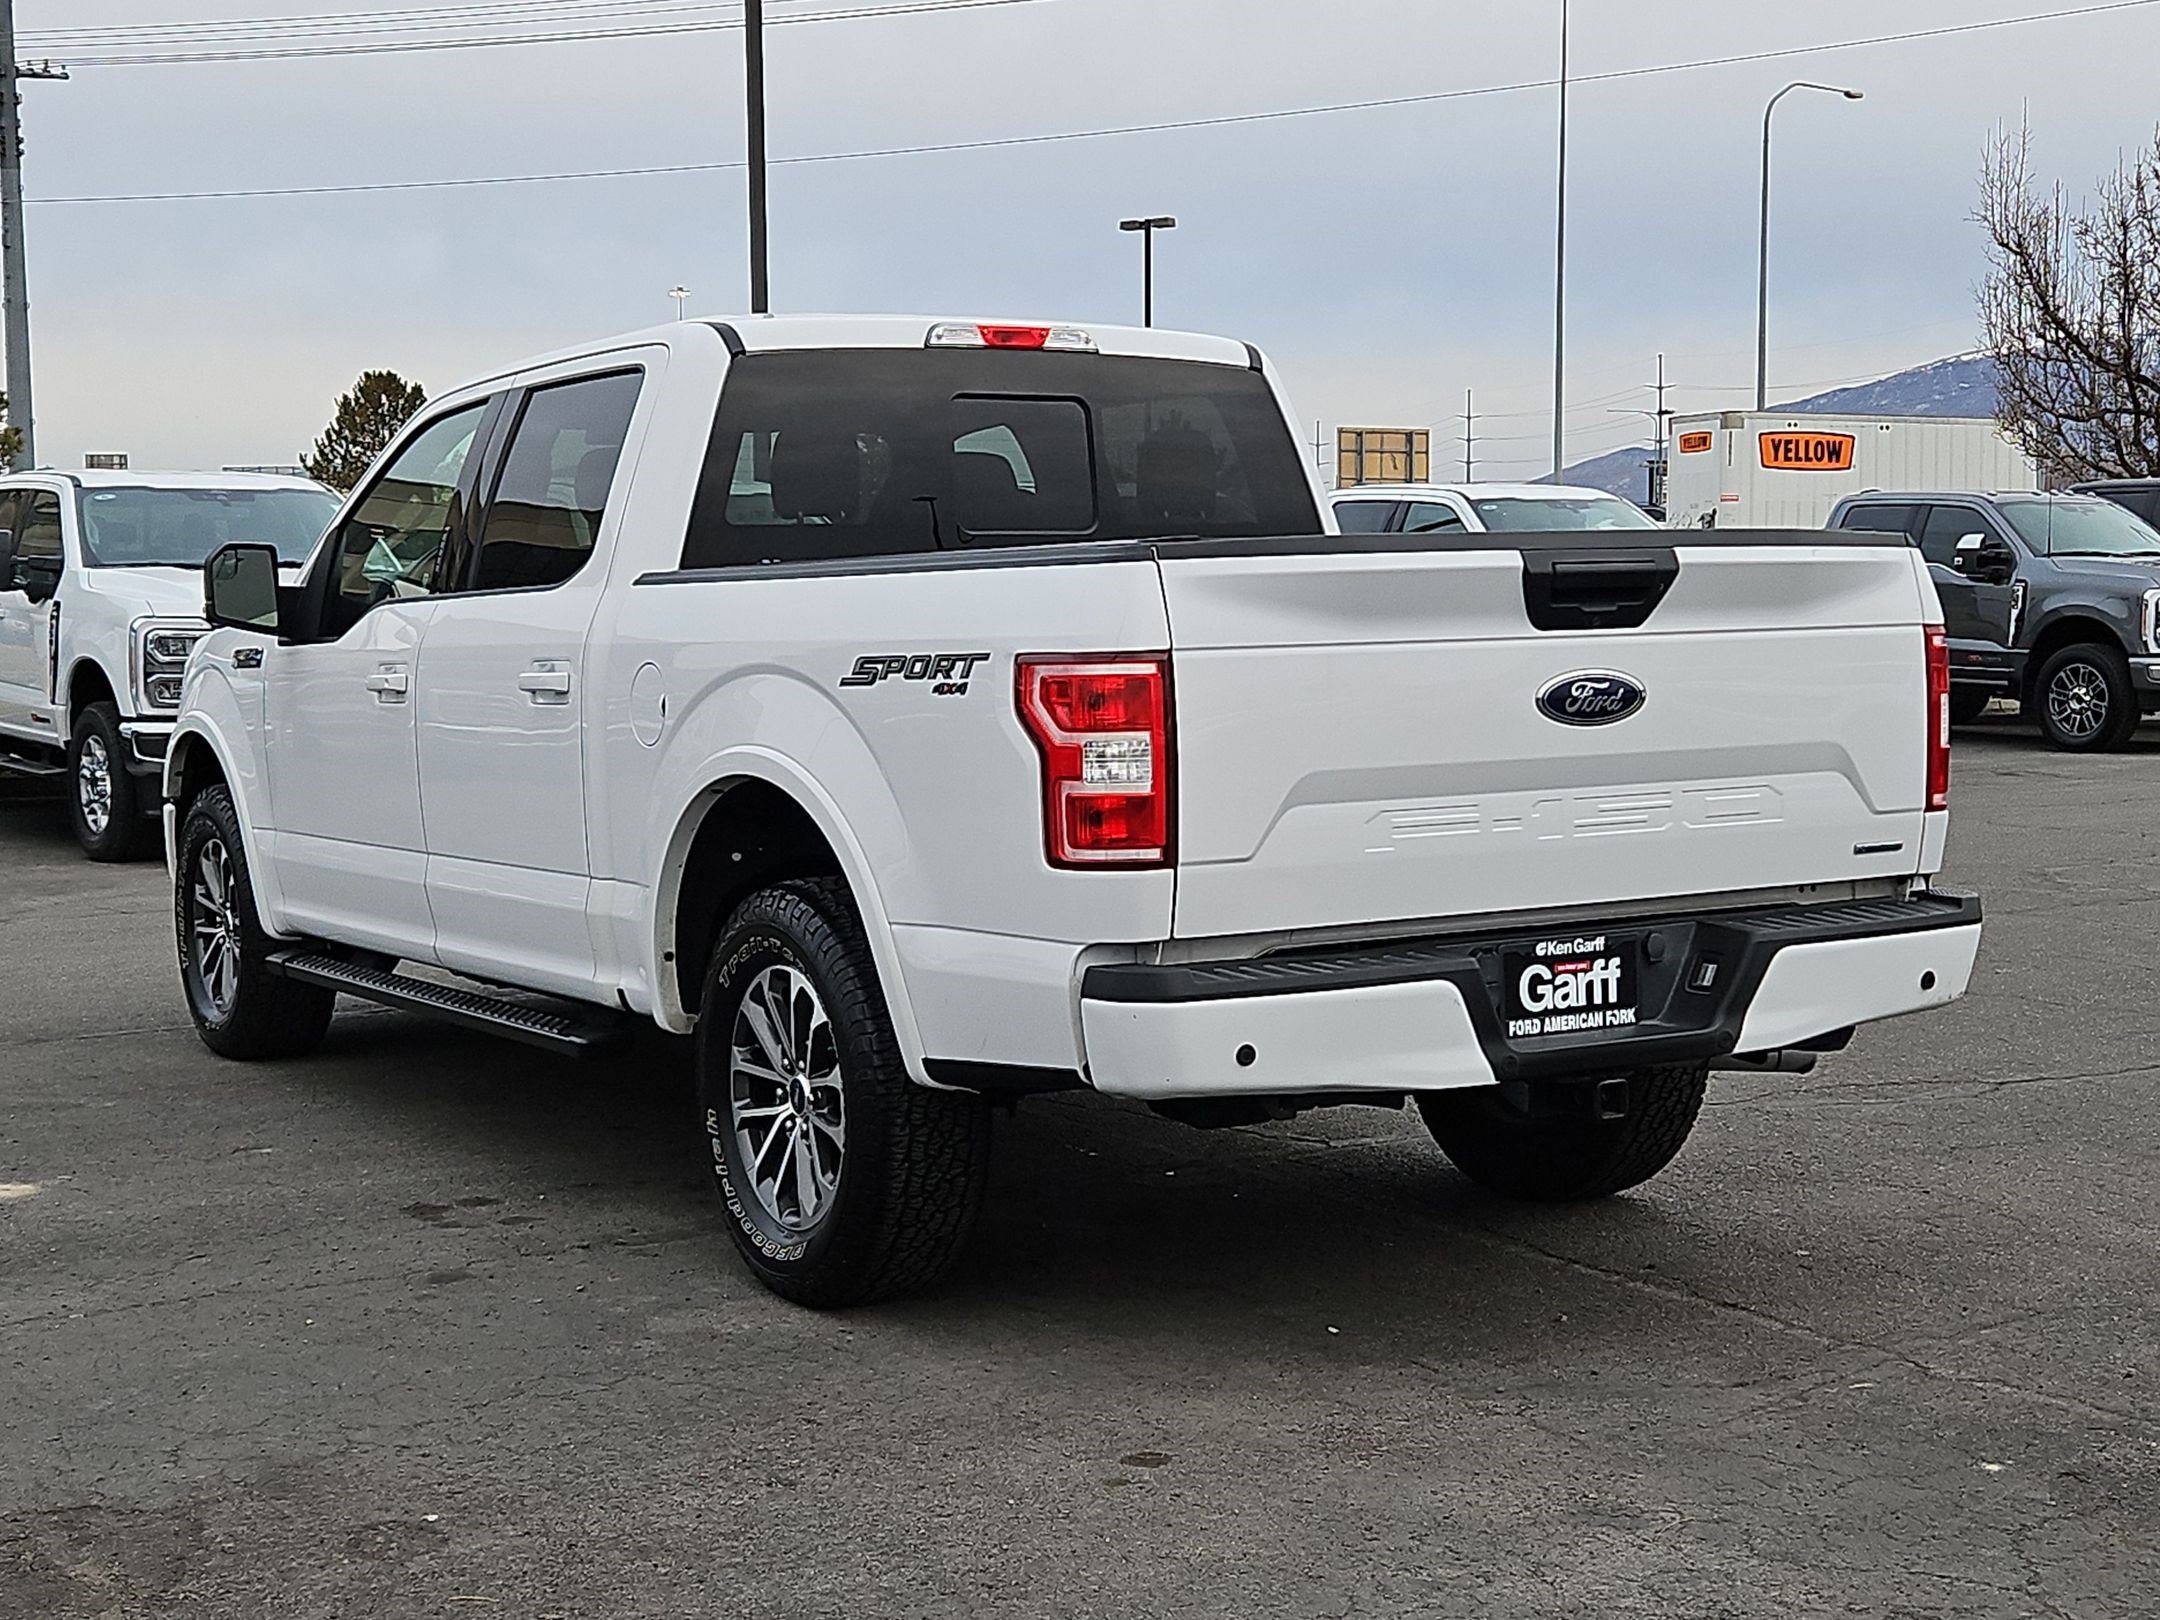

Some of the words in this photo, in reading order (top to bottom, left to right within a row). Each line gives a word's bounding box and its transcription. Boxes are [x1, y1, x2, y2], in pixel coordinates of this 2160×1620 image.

[1770, 438, 1844, 464] YELLOW
[838, 652, 992, 687] SPORT
[1565, 681, 1625, 713] Ford
[1364, 784, 1784, 853] F-150
[1547, 940, 1573, 956] Ken
[1573, 936, 1606, 954] Garff
[1519, 956, 1621, 1013] Garff
[1508, 1018, 1541, 1037] FORD
[1543, 1011, 1604, 1033] AMERICAN
[1605, 1006, 1637, 1026] FORK
